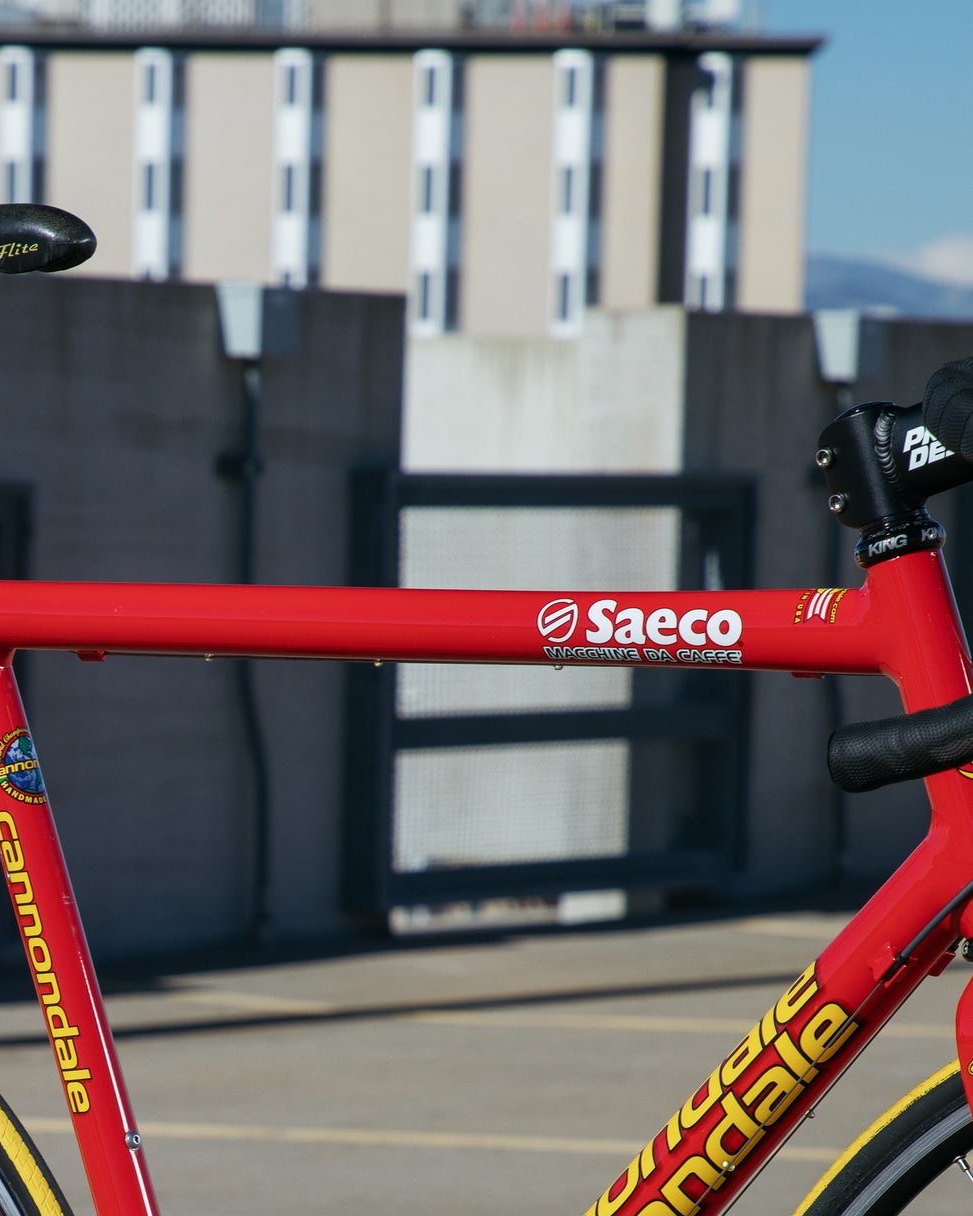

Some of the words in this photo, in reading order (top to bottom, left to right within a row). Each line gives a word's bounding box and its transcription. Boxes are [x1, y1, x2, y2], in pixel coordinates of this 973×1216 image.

[868, 534, 908, 557] KING
[584, 599, 743, 648] Saeco
[543, 646, 642, 662] MACCHINE
[643, 648, 677, 663] DA
